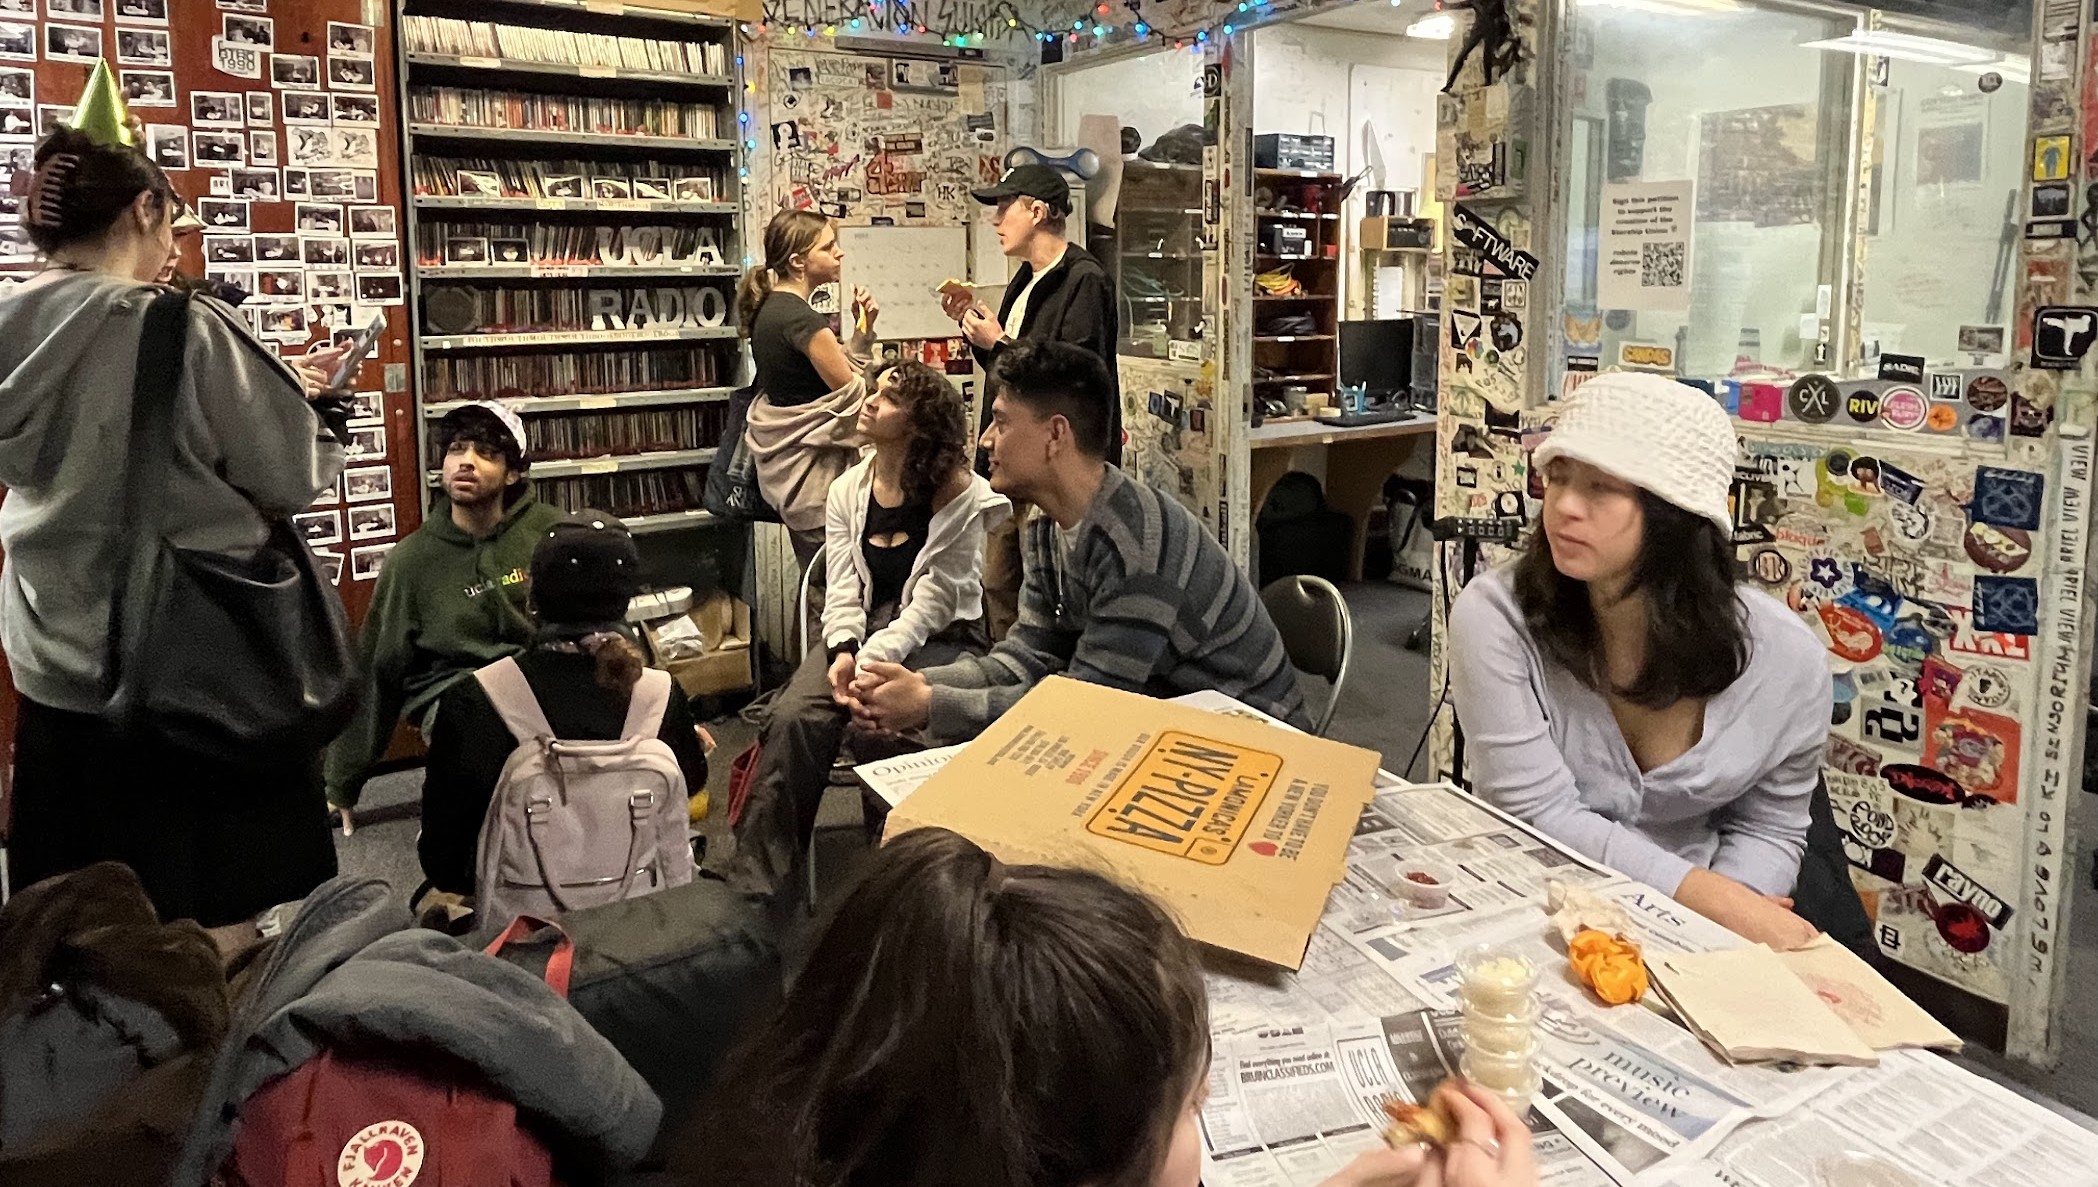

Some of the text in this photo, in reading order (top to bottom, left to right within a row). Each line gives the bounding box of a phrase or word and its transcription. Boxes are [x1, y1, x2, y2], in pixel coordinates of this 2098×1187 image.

[1627, 206, 1657, 214] support
[595, 225, 725, 266] UCLA
[588, 286, 727, 331] RADIO
[2059, 485, 2082, 564] ARIEL VIEW
[872, 754, 953, 776] Opinio
[1277, 846, 1300, 862] BE
[1620, 894, 1686, 926] Arts
[2035, 863, 2050, 931] LOVE
[2031, 931, 2049, 973] WE
[1239, 1059, 1251, 1070] Find
[1252, 1057, 1281, 1070] everything
[1239, 1061, 1337, 1084] BRUINCLASSIFIEDS.COM
[1347, 1047, 1392, 1089] UCLA
[1603, 1051, 1691, 1098] music
[1568, 1057, 1684, 1118] preview
[1600, 1102, 1637, 1125] every
[1637, 1121, 1682, 1149] mood
